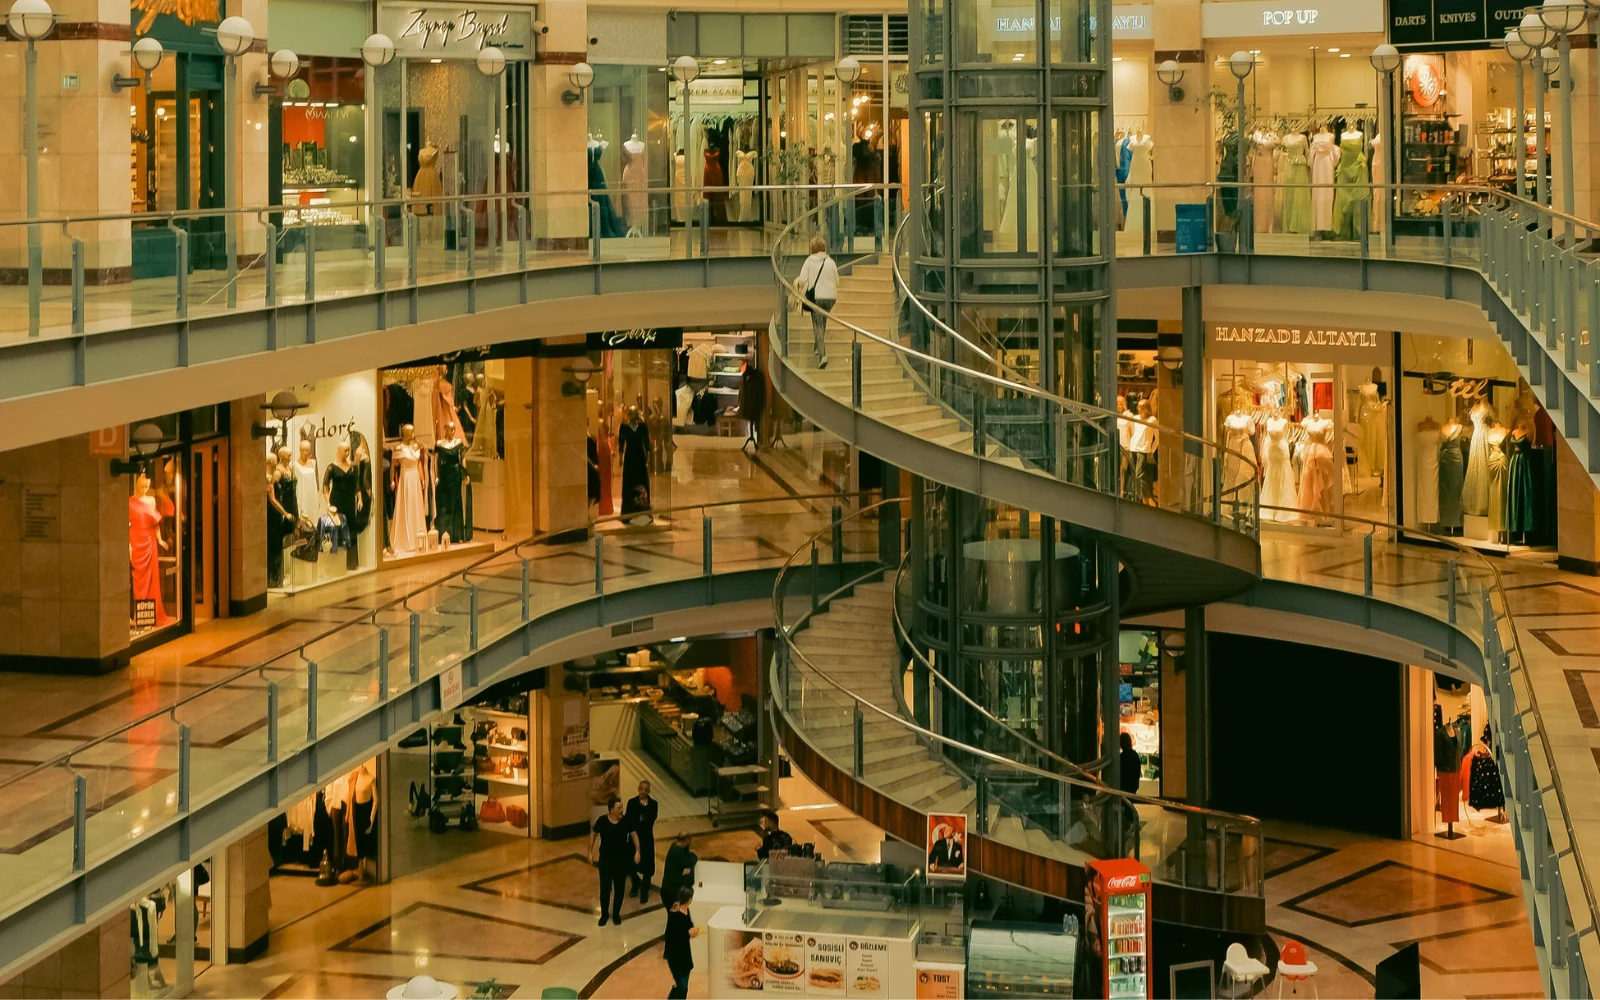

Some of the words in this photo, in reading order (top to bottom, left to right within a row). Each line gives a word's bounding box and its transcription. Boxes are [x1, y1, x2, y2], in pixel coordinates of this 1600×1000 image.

[1262, 11, 1293, 25] POP
[1296, 10, 1318, 24] UP
[1395, 15, 1426, 26] DARTS
[1440, 12, 1476, 24] KNIVES
[400, 8, 455, 49] Zeynep
[1216, 327, 1301, 344] HANZADE
[1304, 330, 1377, 347] ALTAYLI
[933, 974, 950, 983] TOST
